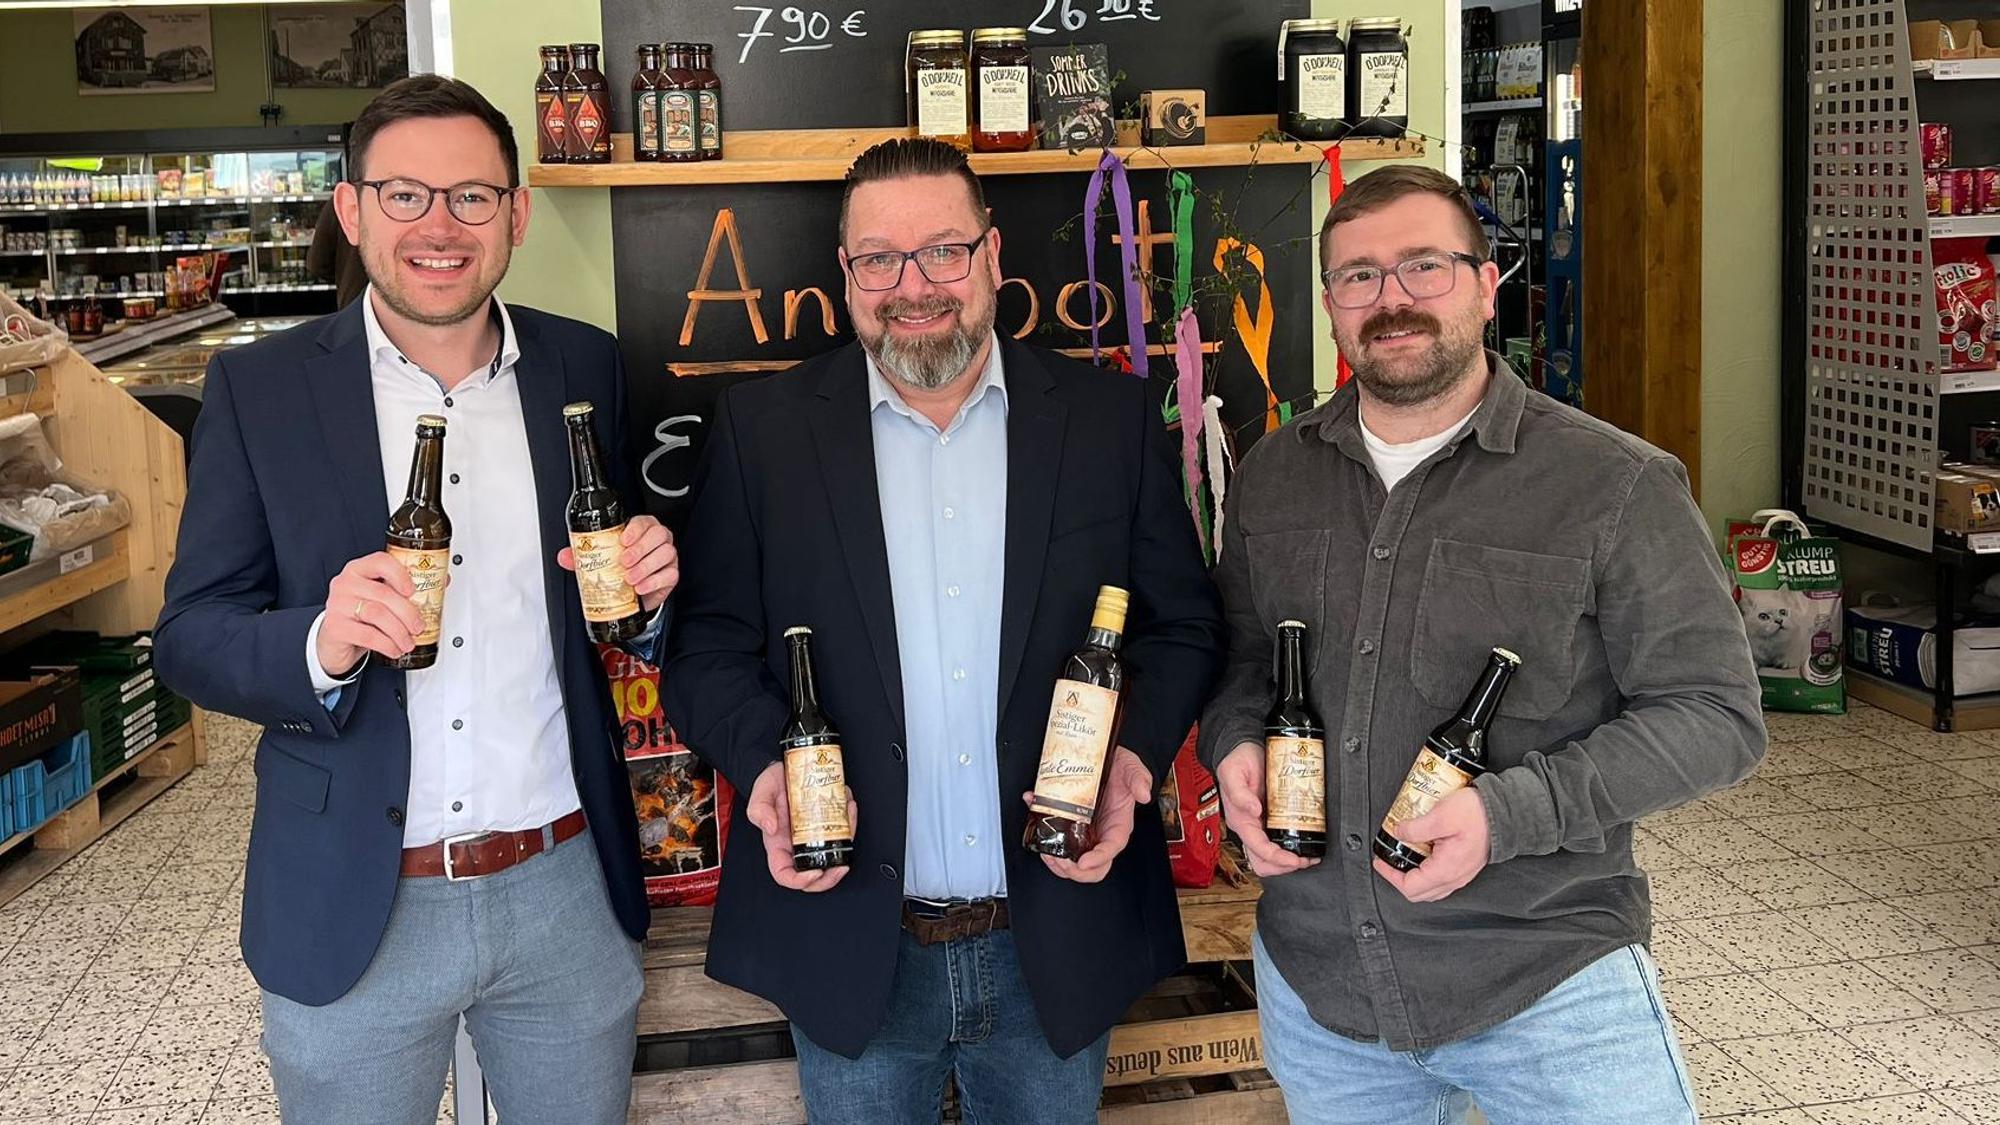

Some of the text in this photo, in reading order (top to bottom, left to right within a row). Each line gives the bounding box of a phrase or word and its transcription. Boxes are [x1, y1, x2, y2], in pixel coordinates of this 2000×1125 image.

[841, 11, 867, 37] €
[1046, 69, 1100, 97] DRINKS
[641, 414, 702, 497] E
[1777, 559, 1836, 576] STREU
[1881, 627, 1893, 677] STREU
[1055, 758, 1095, 774] Emma
[1106, 1036, 1260, 1077] Wein aus deuts
